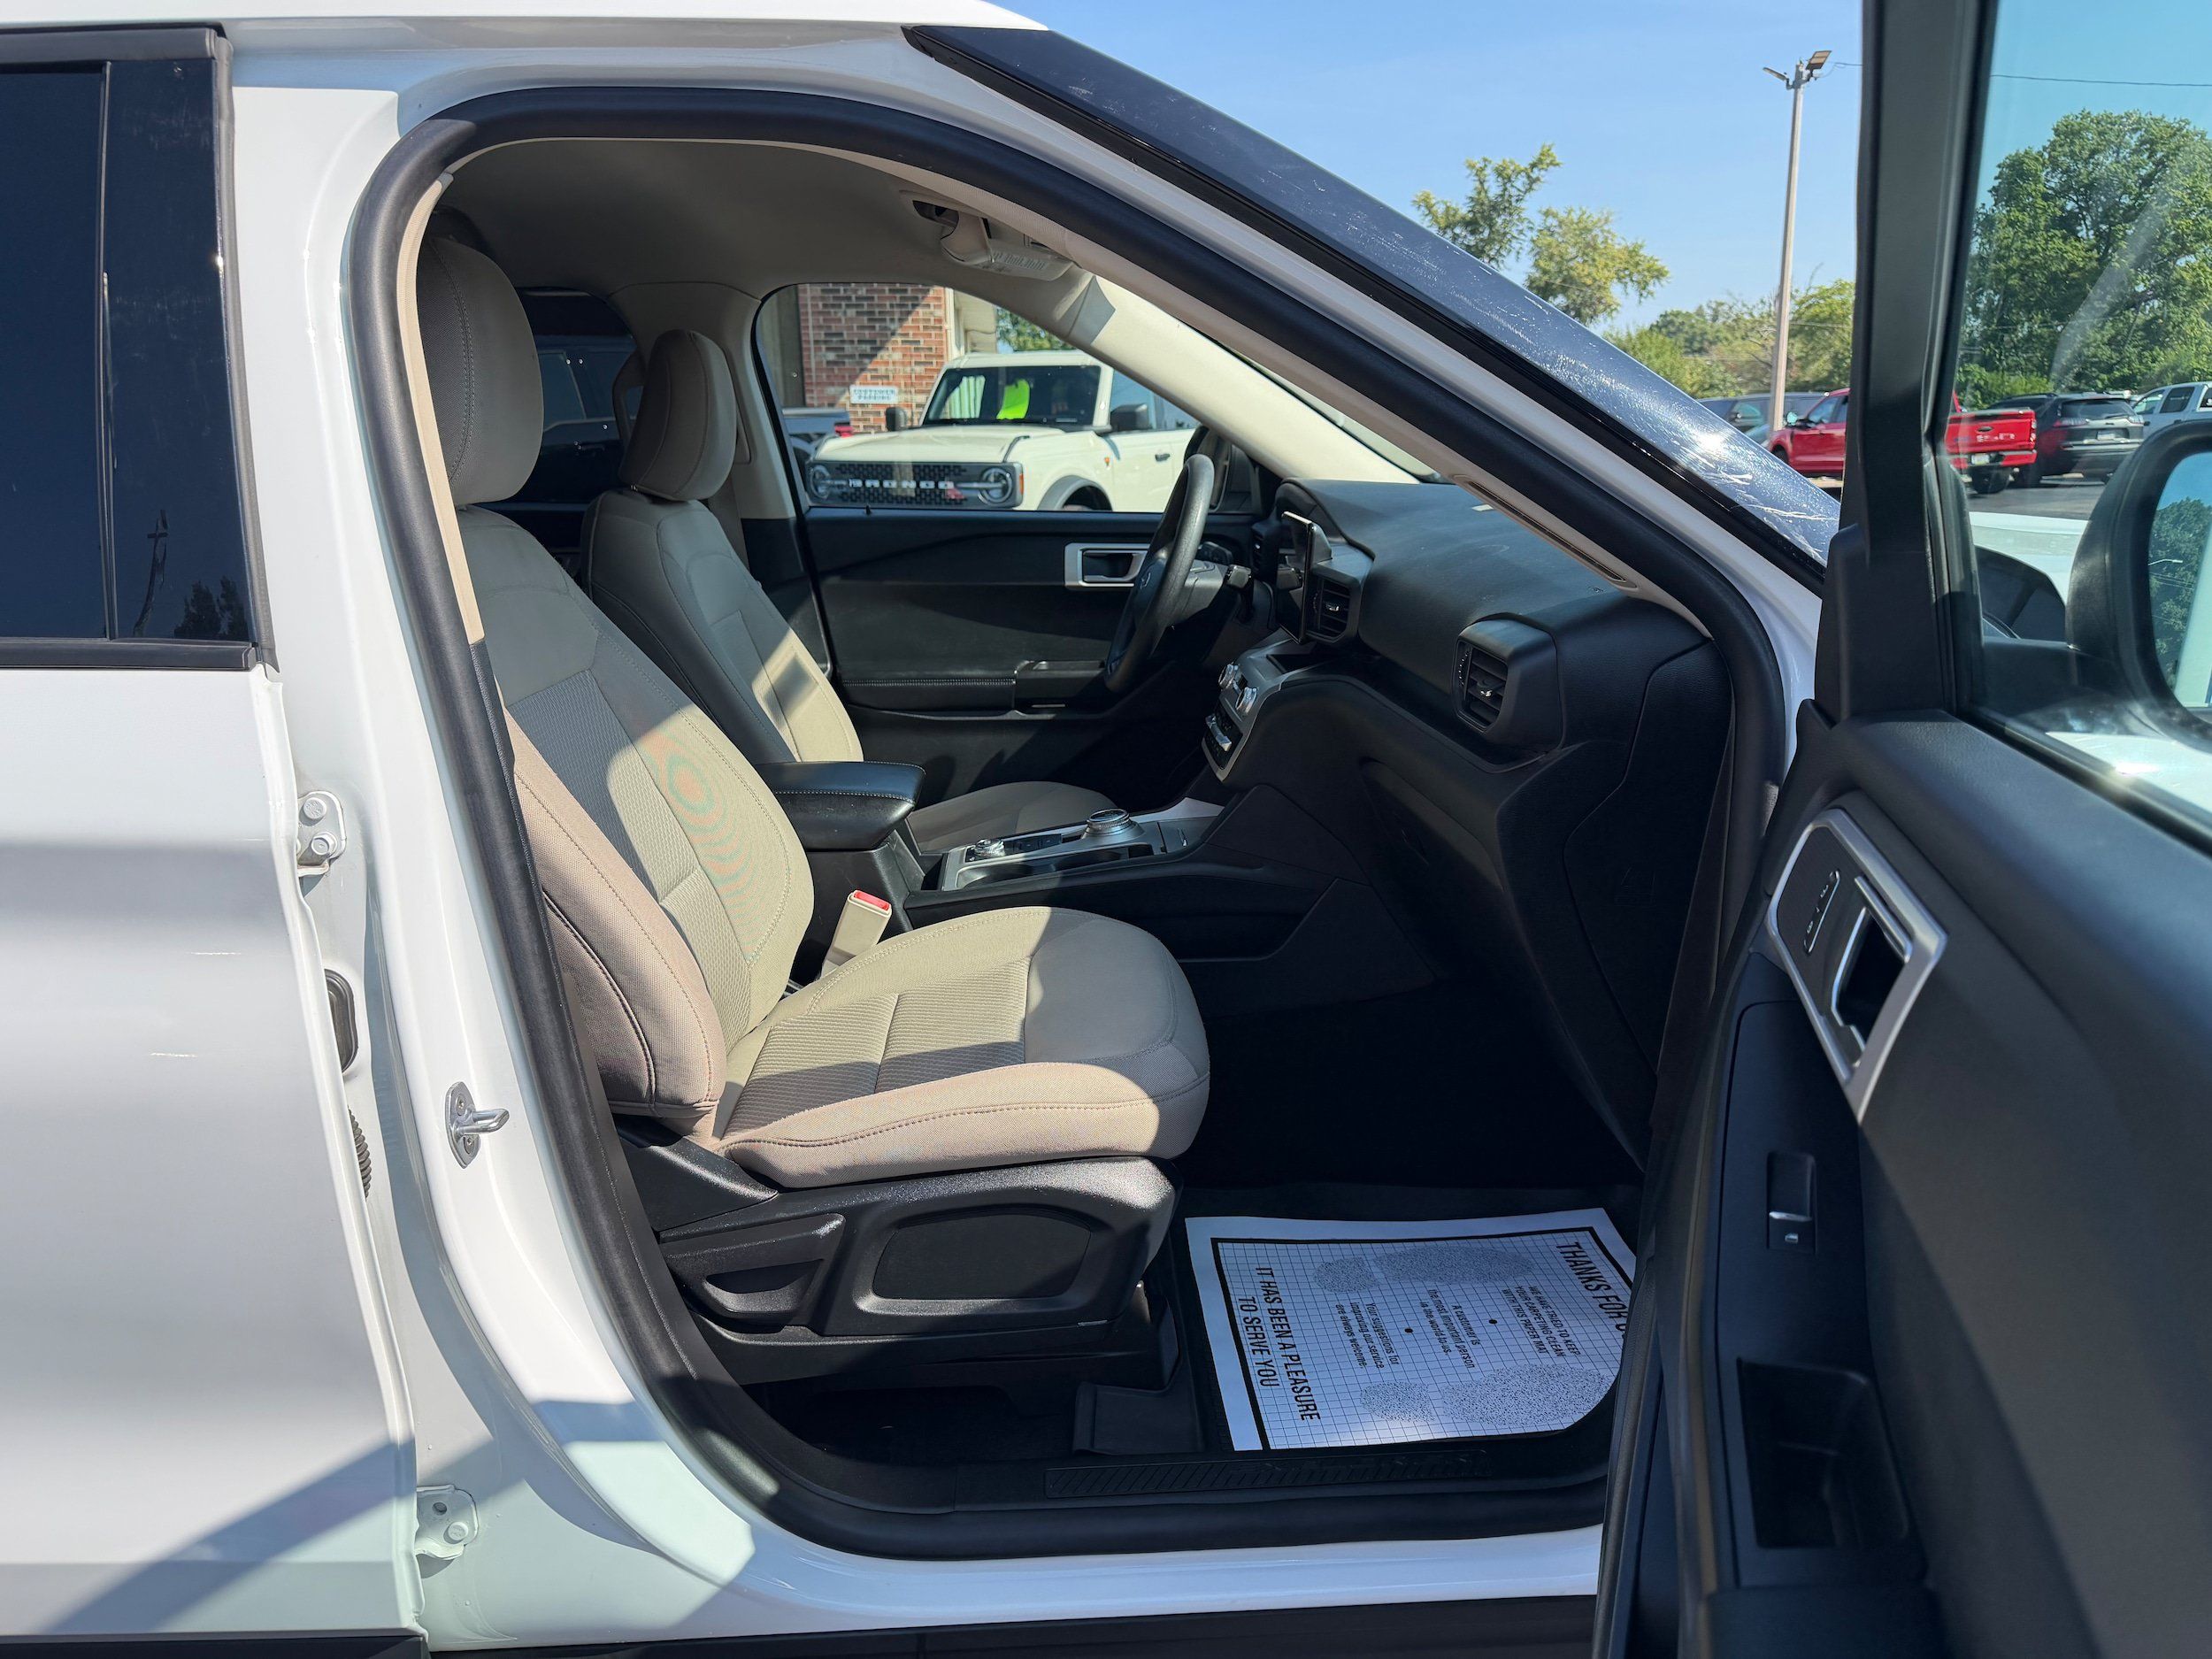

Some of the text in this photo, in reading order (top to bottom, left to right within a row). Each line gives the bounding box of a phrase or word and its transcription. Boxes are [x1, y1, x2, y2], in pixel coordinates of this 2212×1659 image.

[849, 479, 955, 488] BRONCO
[1336, 1304, 1346, 1315] are
[1556, 1241, 1628, 1318] THANKS FOR
[1239, 1296, 1279, 1387] TO SERVE YOU
[1256, 1267, 1321, 1421] IT HAS BEEN A PLEASURE
[1340, 1316, 1355, 1338] always
[1349, 1302, 1385, 1369] improving our service
[1365, 1302, 1400, 1364] Your suggestions for
[1423, 1309, 1434, 1318] the
[1428, 1319, 1446, 1337] world
[1428, 1289, 1475, 1369] the most important person
[1455, 1310, 1476, 1339] customer
[1502, 1288, 1548, 1354] WITH THIS PAPER MAT
[1515, 1286, 1566, 1357] YOUR CARPETING CLEAN
[1529, 1286, 1581, 1356] WE HAVE TRIED TO KEEP
